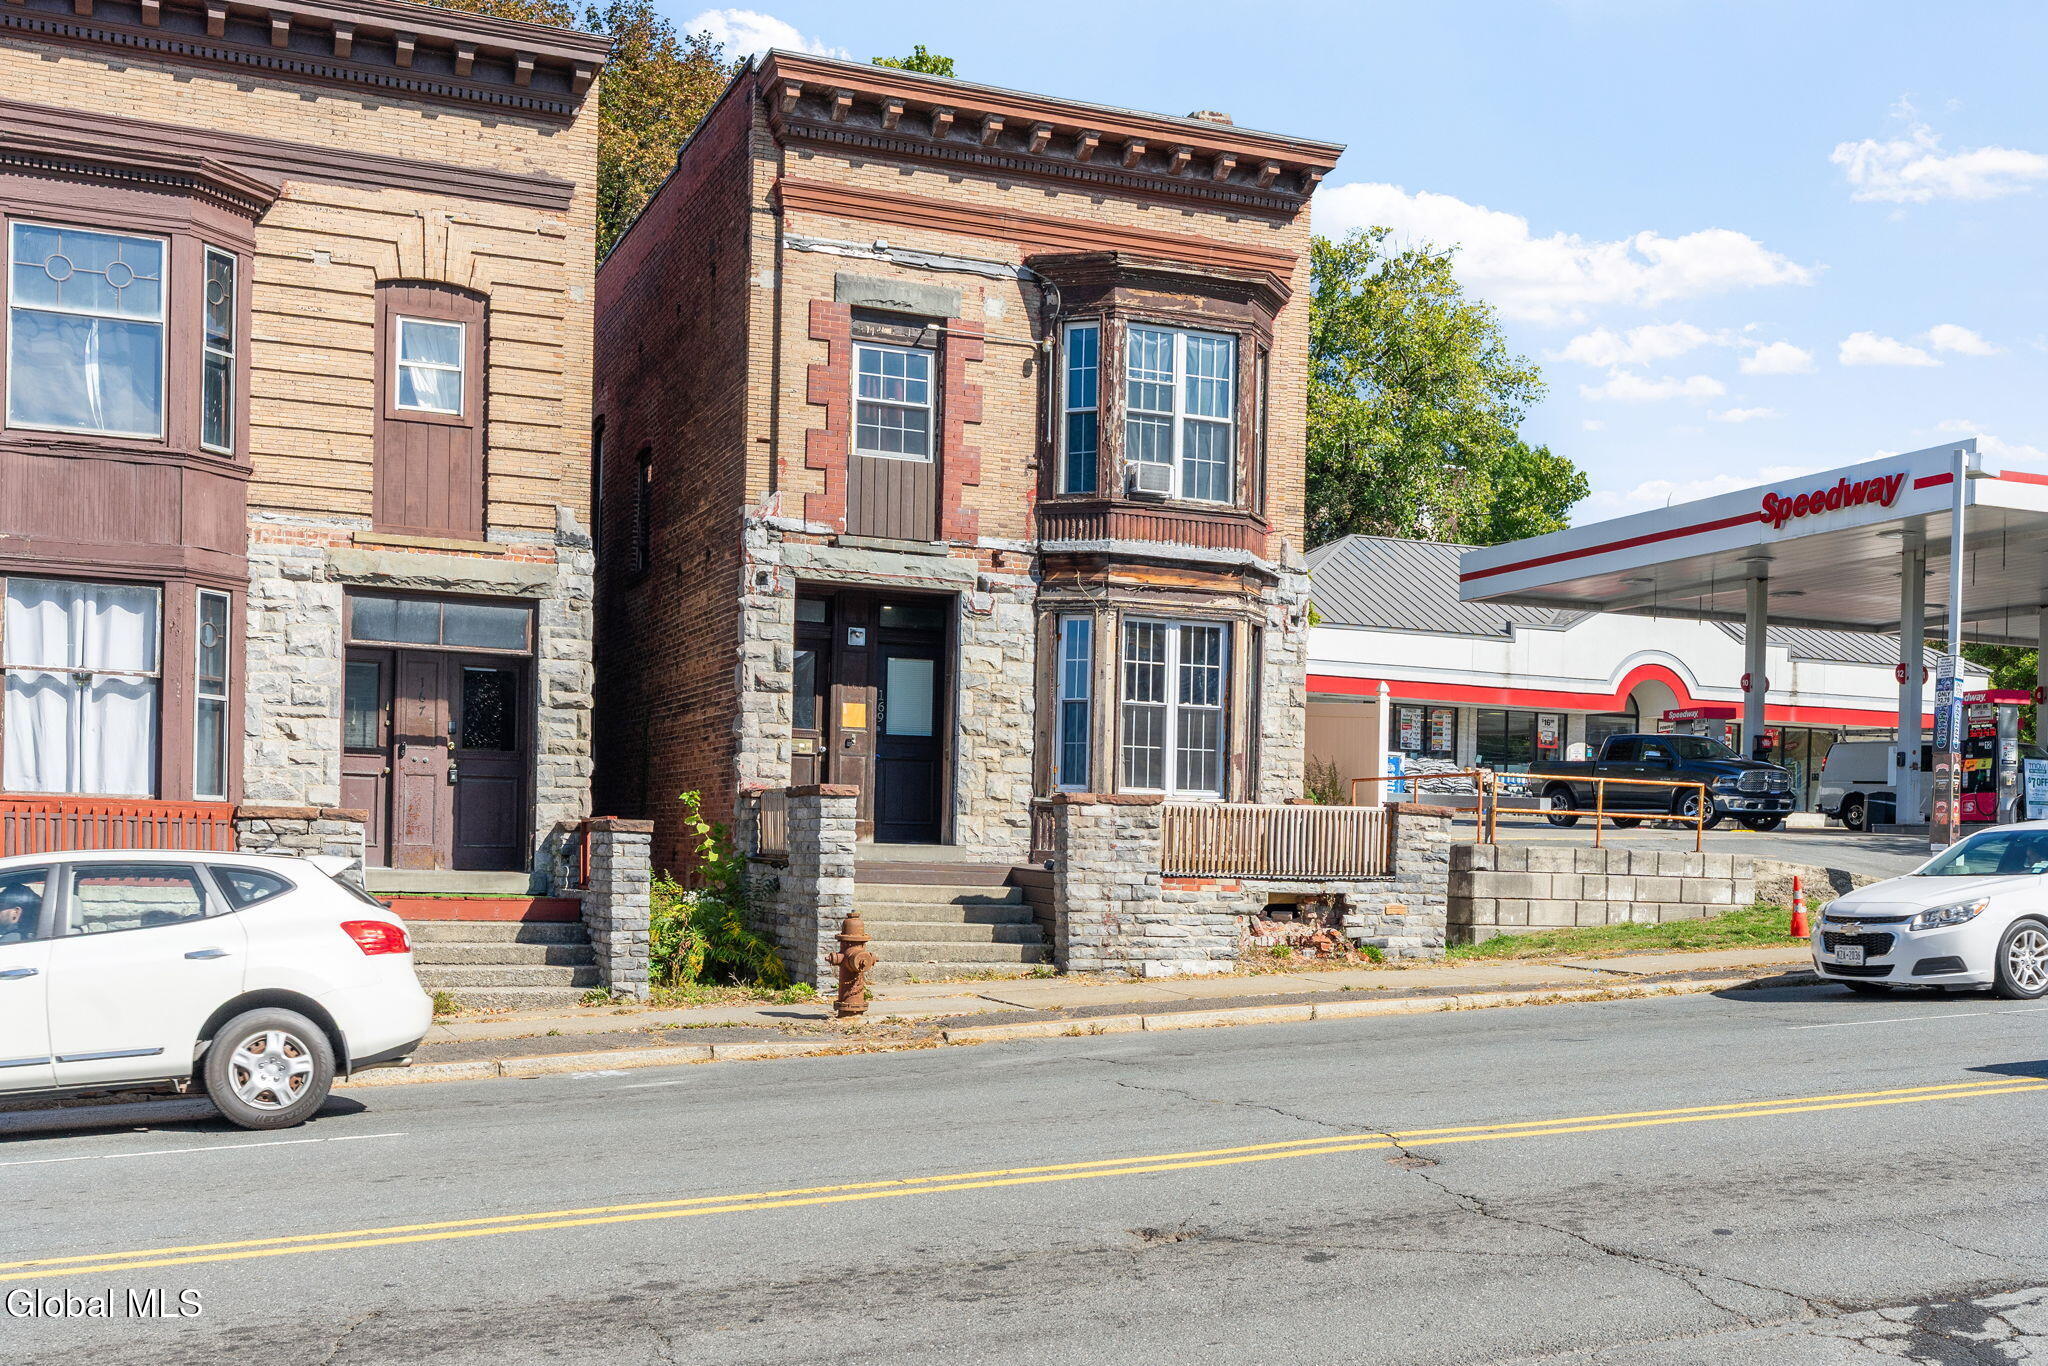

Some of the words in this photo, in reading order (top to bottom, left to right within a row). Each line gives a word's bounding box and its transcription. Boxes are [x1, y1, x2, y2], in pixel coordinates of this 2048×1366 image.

[1760, 472, 1905, 530] Speedway
[1897, 670, 1904, 678] 12
[1741, 679, 1749, 687] 10
[1964, 693, 1985, 702] dway
[877, 689, 885, 723] 169
[1668, 710, 1698, 720] Speedway
[1984, 741, 1992, 749] 12
